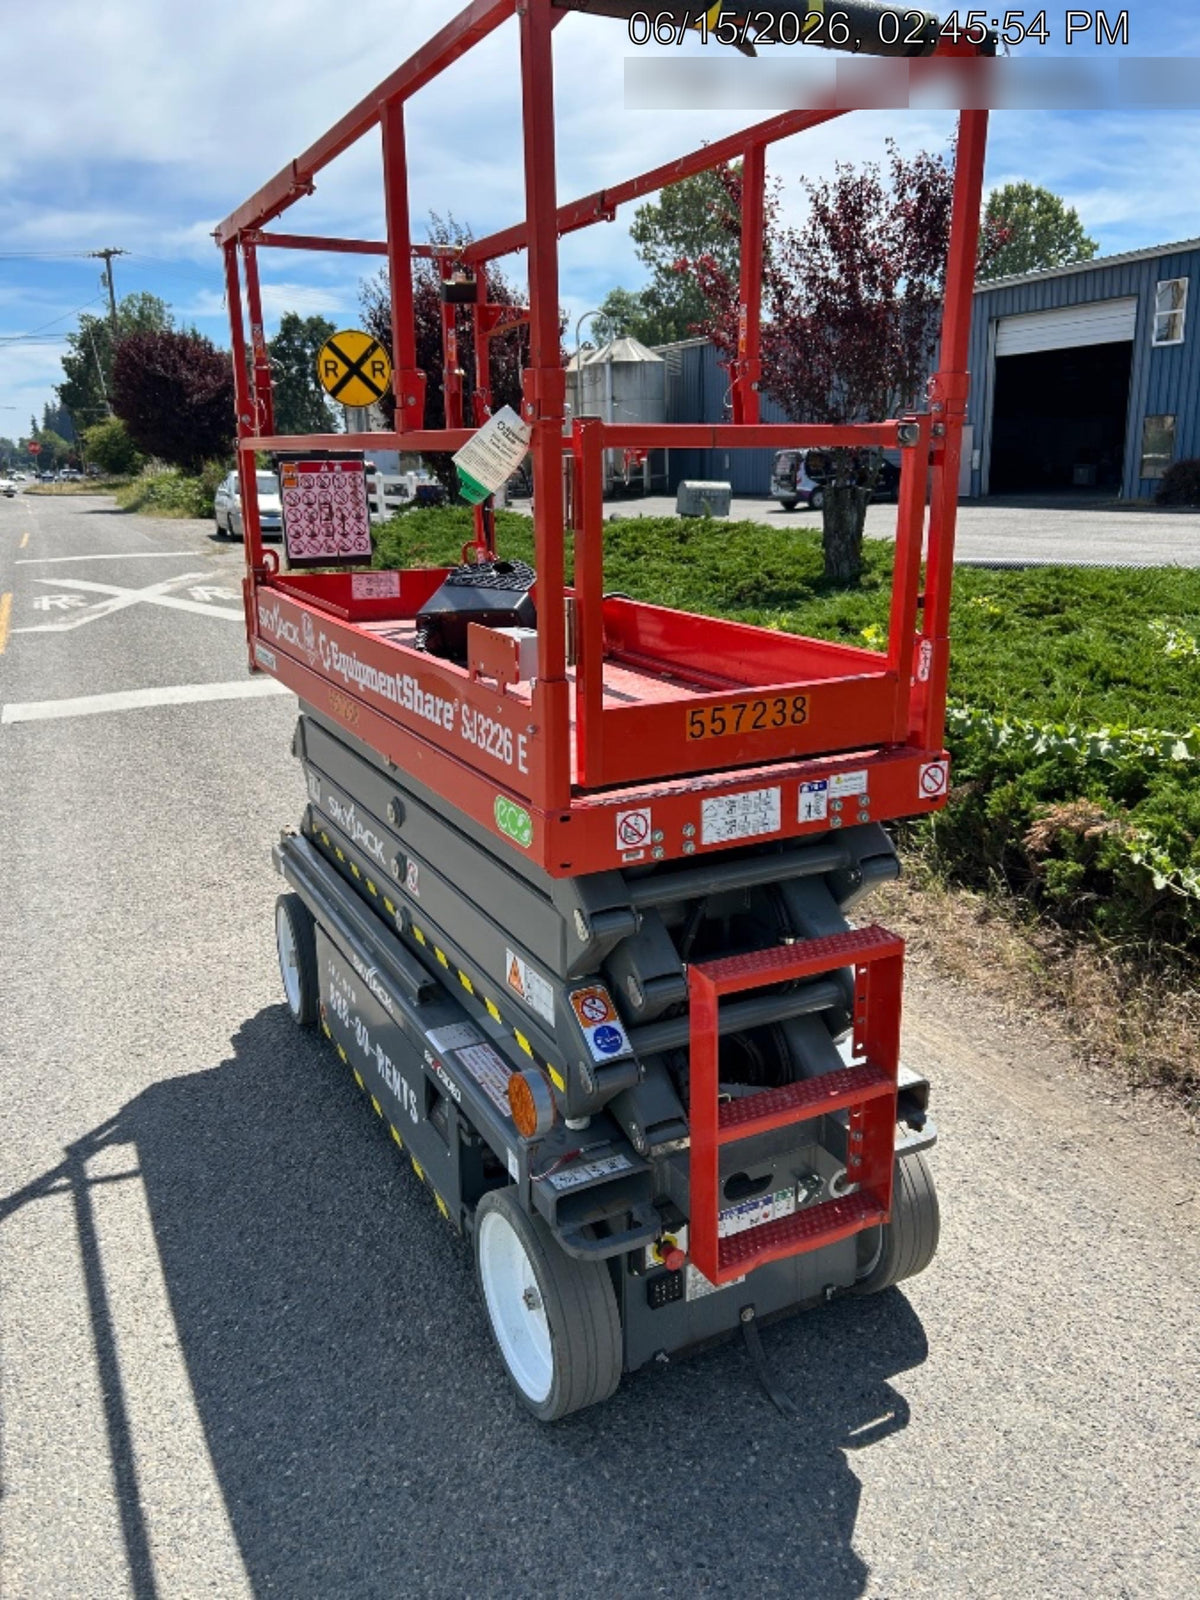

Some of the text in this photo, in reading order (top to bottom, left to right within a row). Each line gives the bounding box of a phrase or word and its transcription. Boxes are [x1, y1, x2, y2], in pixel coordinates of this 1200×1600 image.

[324, 360, 386, 379] R R
[461, 703, 513, 766] SJ3226
[517, 733, 529, 775] E
[689, 696, 807, 739] 557238
[328, 795, 387, 866] SKYJACK
